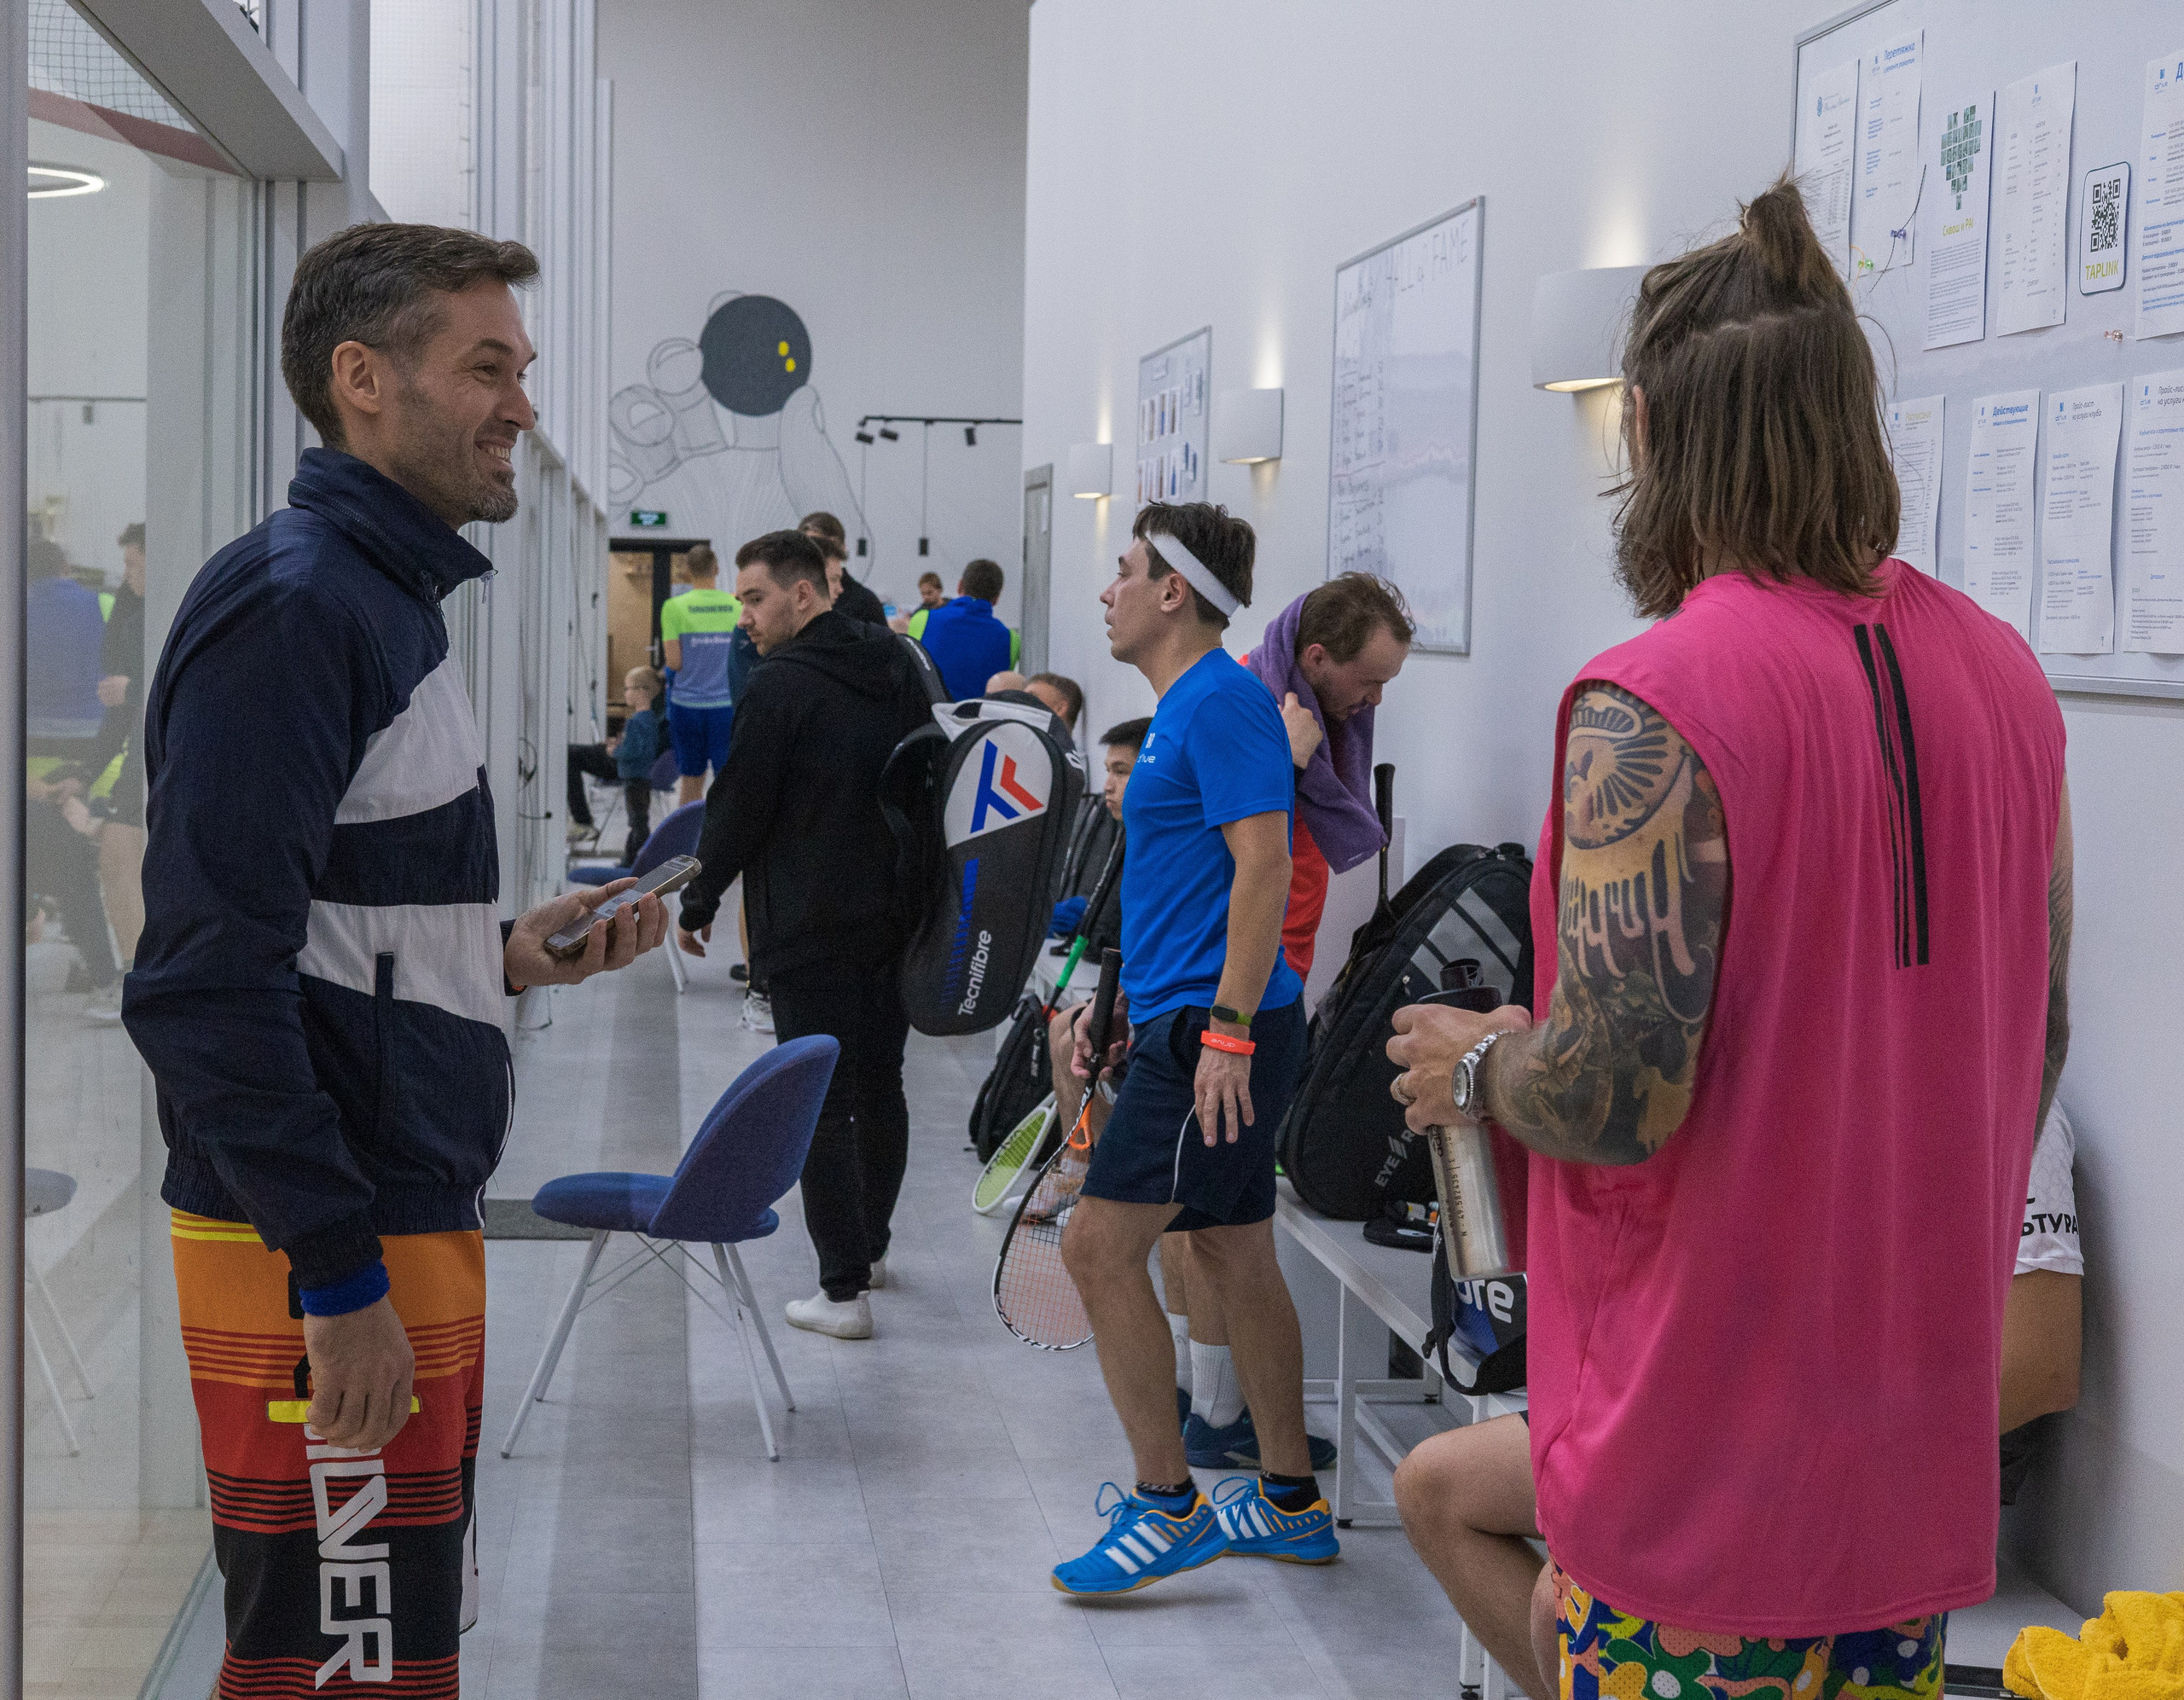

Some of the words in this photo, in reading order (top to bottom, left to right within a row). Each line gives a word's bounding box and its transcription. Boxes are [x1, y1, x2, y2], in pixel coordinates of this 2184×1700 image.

[1943, 224, 1960, 236] Сквош
[2085, 259, 2119, 281] TAPLINK
[1992, 403, 2029, 417] Действующие
[957, 930, 992, 1015] Tecnifibre
[1211, 1037, 1236, 1048] drive
[1374, 1155, 1401, 1187] EYE
